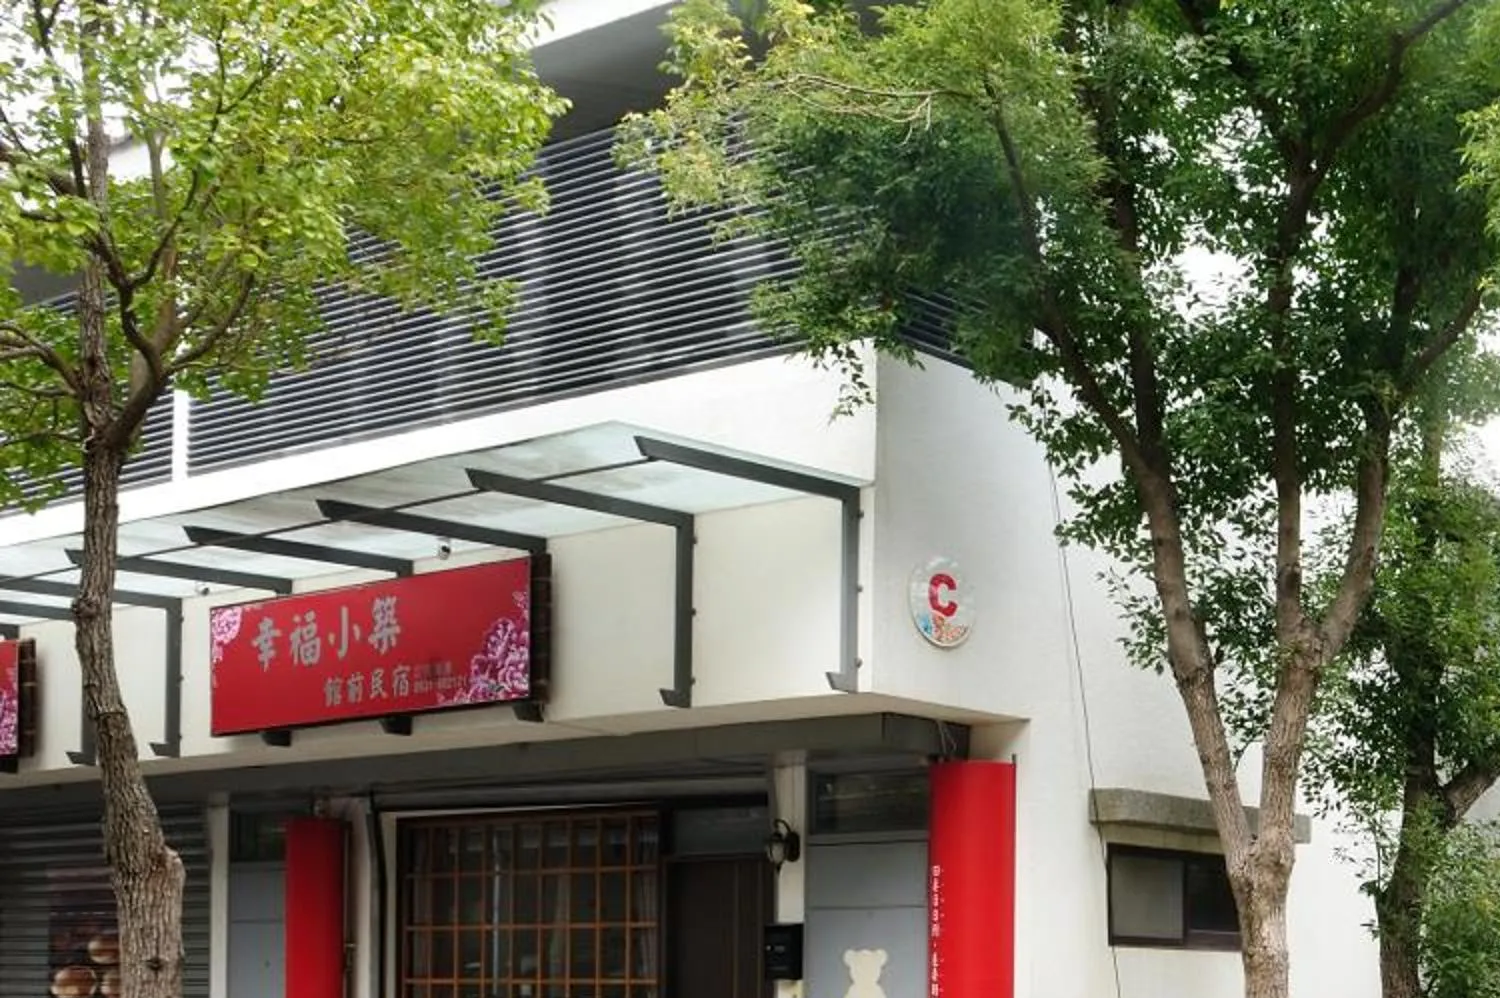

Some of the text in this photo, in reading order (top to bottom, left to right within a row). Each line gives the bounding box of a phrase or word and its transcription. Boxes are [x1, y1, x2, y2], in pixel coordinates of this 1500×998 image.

[929, 573, 957, 617] C
[252, 596, 400, 671] 幸福小築
